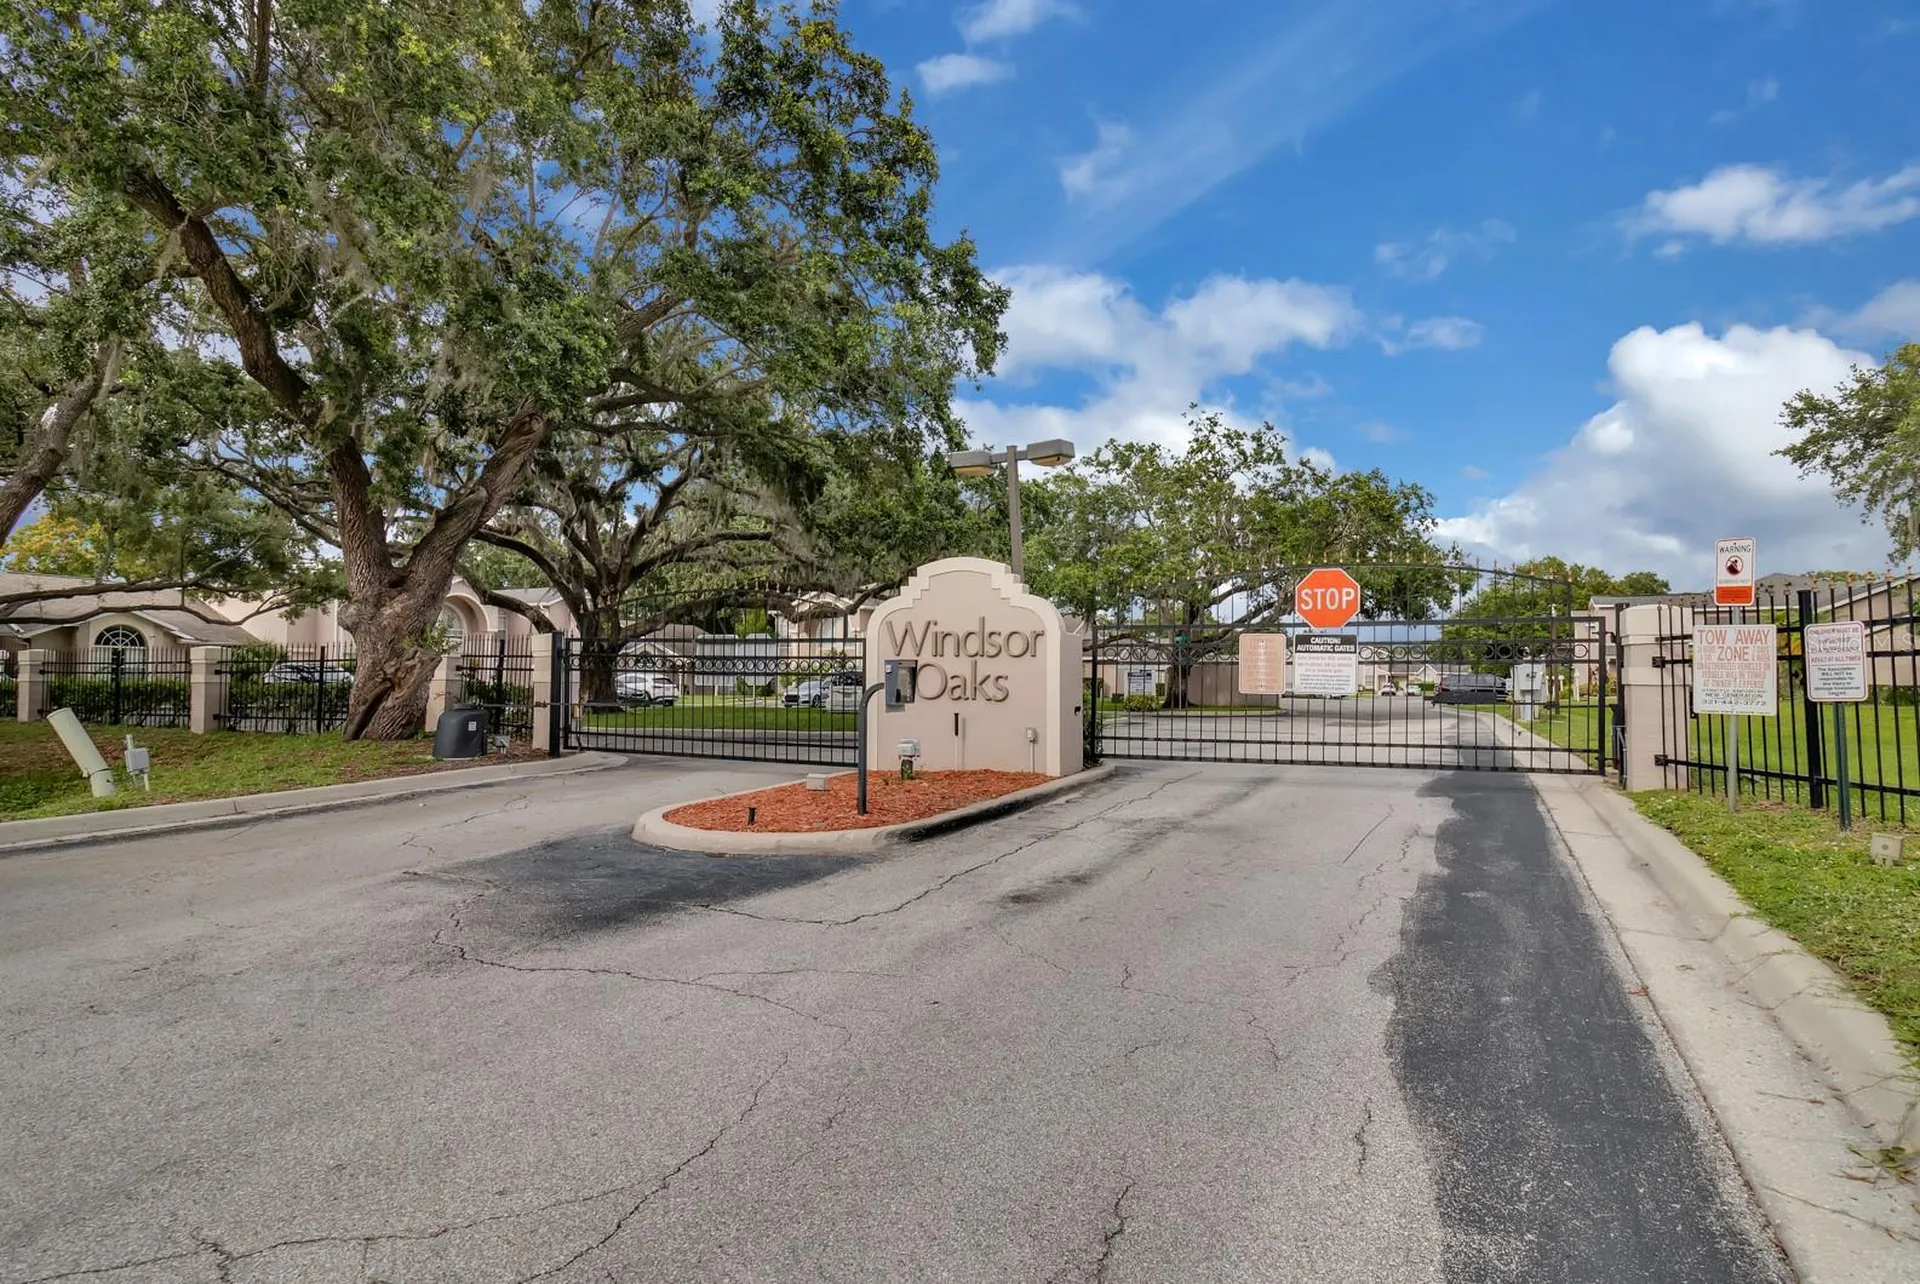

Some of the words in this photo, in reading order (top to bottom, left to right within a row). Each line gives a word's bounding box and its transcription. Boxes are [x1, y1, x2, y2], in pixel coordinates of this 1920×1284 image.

[1719, 544, 1752, 553] WARNING
[1300, 587, 1355, 610] STOP
[885, 616, 1045, 658] Windsor
[1697, 629, 1727, 645] TOW
[1735, 629, 1770, 645] AWAY
[1296, 644, 1334, 652] AUTOMATIC
[1717, 646, 1750, 662] ZONE
[916, 659, 1010, 703] Oaks
